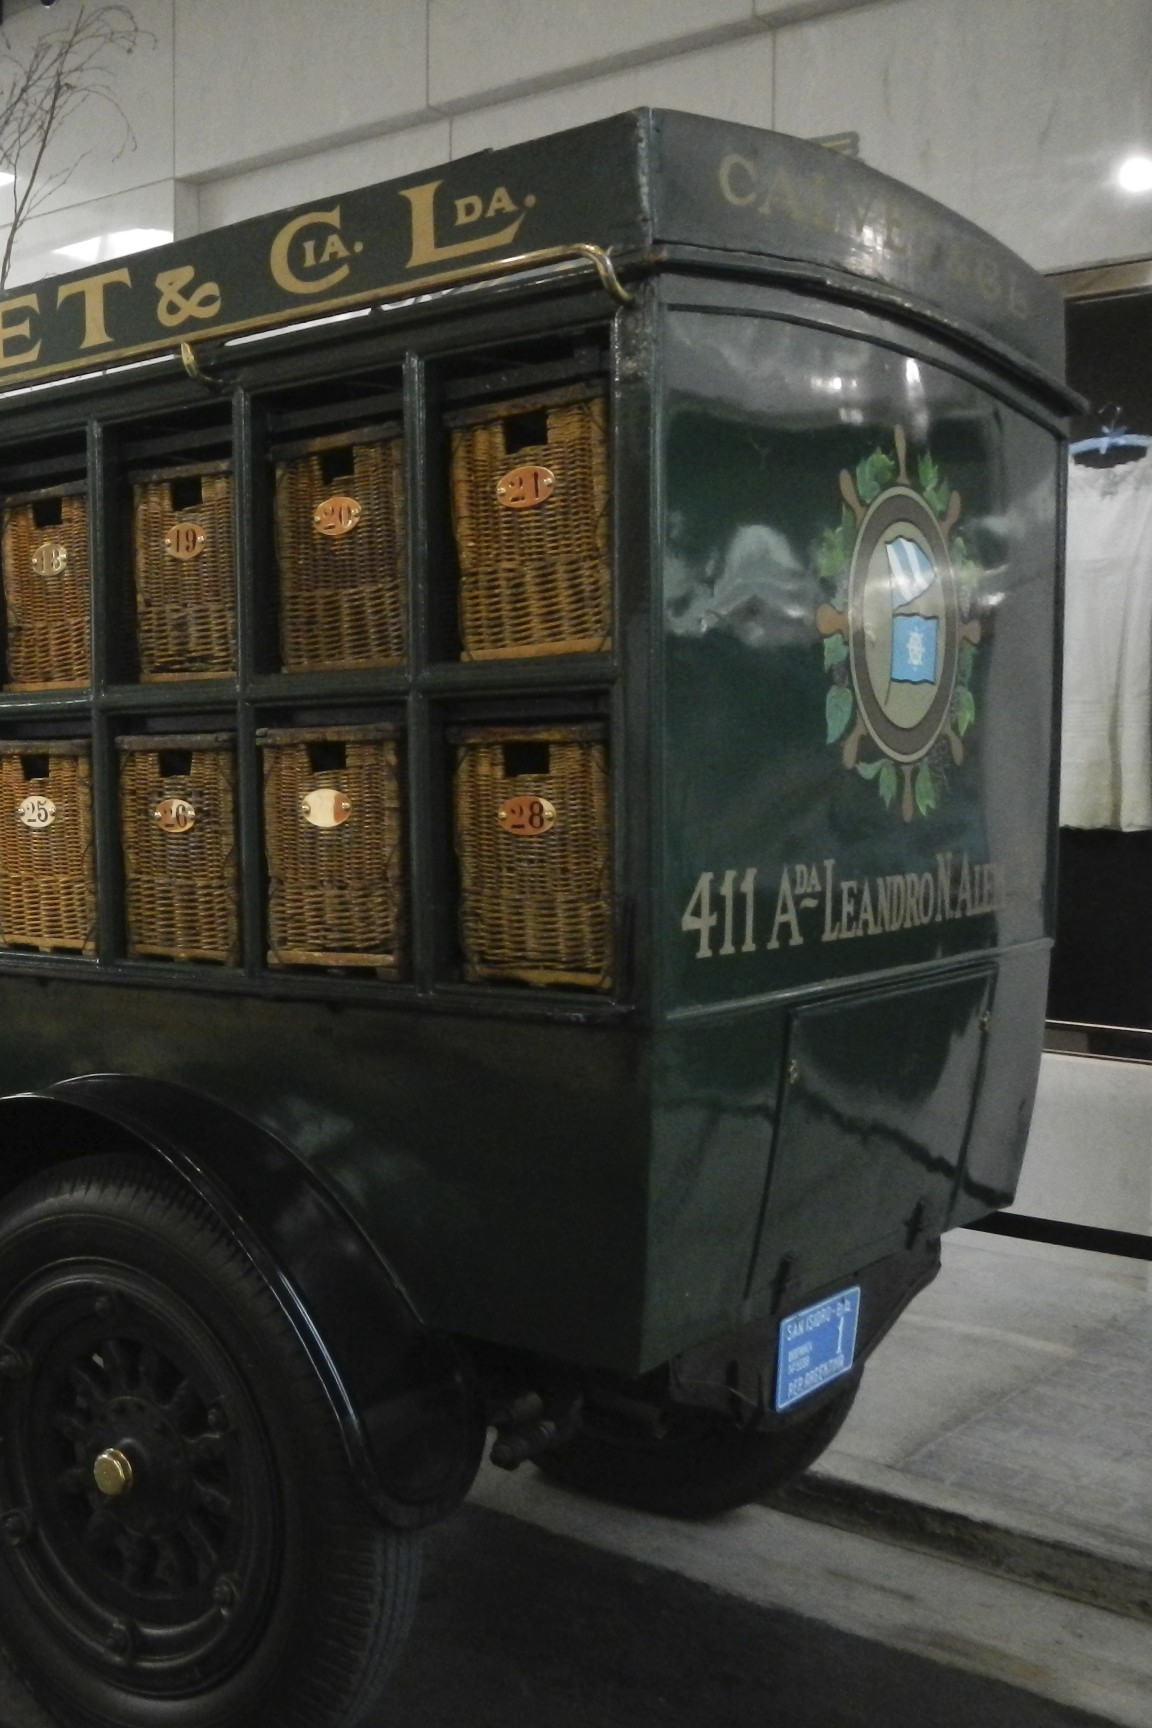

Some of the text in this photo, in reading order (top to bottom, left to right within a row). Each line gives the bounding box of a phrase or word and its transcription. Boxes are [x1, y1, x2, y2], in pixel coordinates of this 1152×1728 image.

[156, 265, 221, 327] &
[508, 471, 539, 503] 21
[324, 503, 352, 531] 20
[176, 528, 197, 553] 19
[41, 549, 63, 572] 18
[26, 800, 49, 823] 25
[161, 803, 188, 829] 26
[510, 800, 545, 830] 28
[682, 868, 757, 960] 411
